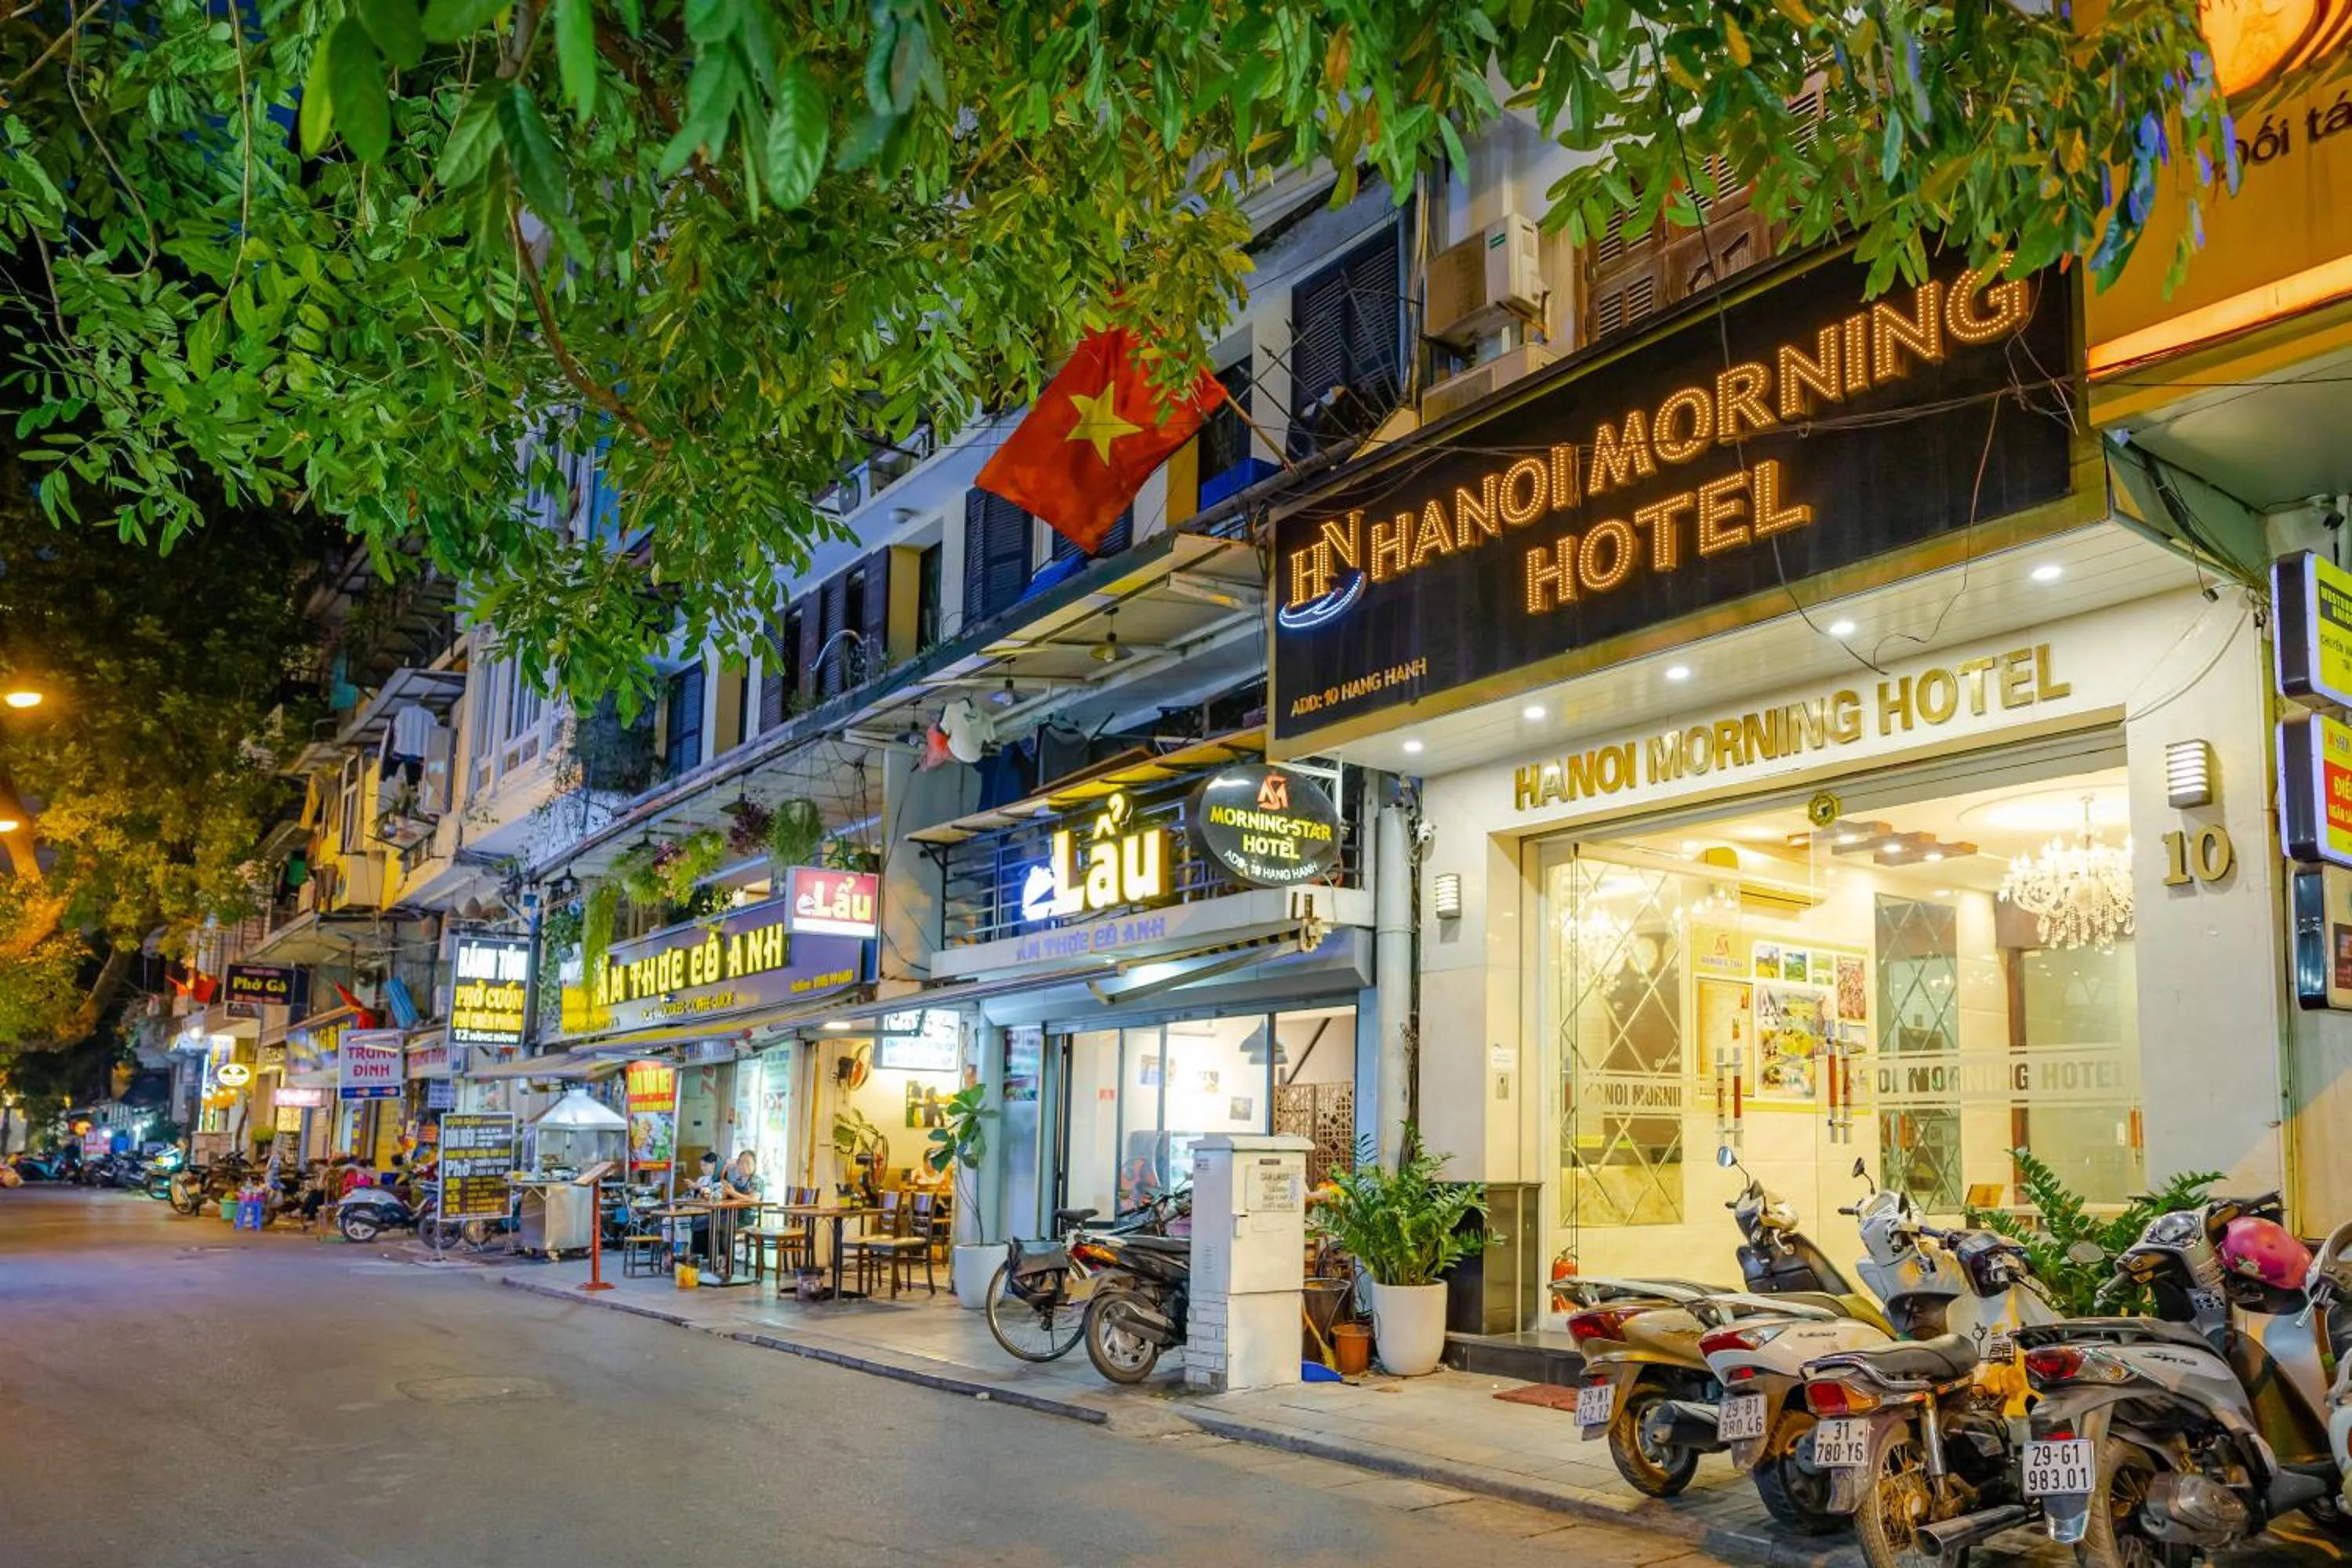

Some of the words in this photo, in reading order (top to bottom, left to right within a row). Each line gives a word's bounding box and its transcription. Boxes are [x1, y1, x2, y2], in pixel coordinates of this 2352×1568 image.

[1371, 443, 1578, 583] HANOI
[1588, 251, 2031, 495] MORNING
[1525, 459, 1811, 615] HOTEL
[1341, 672, 1382, 701] HANG
[1384, 656, 1427, 688] HANH
[1514, 740, 1638, 811] HANOI
[1646, 688, 1864, 785] MORNING
[1877, 643, 2073, 737] HOTEL
[1053, 793, 1169, 914] Lẩu
[1242, 833, 1301, 860] HOTEL
[2161, 824, 2233, 888] 10
[812, 876, 873, 921] Lẩu
[1123, 915, 1166, 941] ANH
[629, 946, 685, 1000] THỰC
[690, 932, 720, 986] CÔ
[727, 922, 784, 978] ANH
[455, 1029, 470, 1041] 12
[1835, 1421, 1849, 1440] 31
[2032, 1444, 2078, 1467] 29-G1
[2028, 1467, 2087, 1491] 983.01
